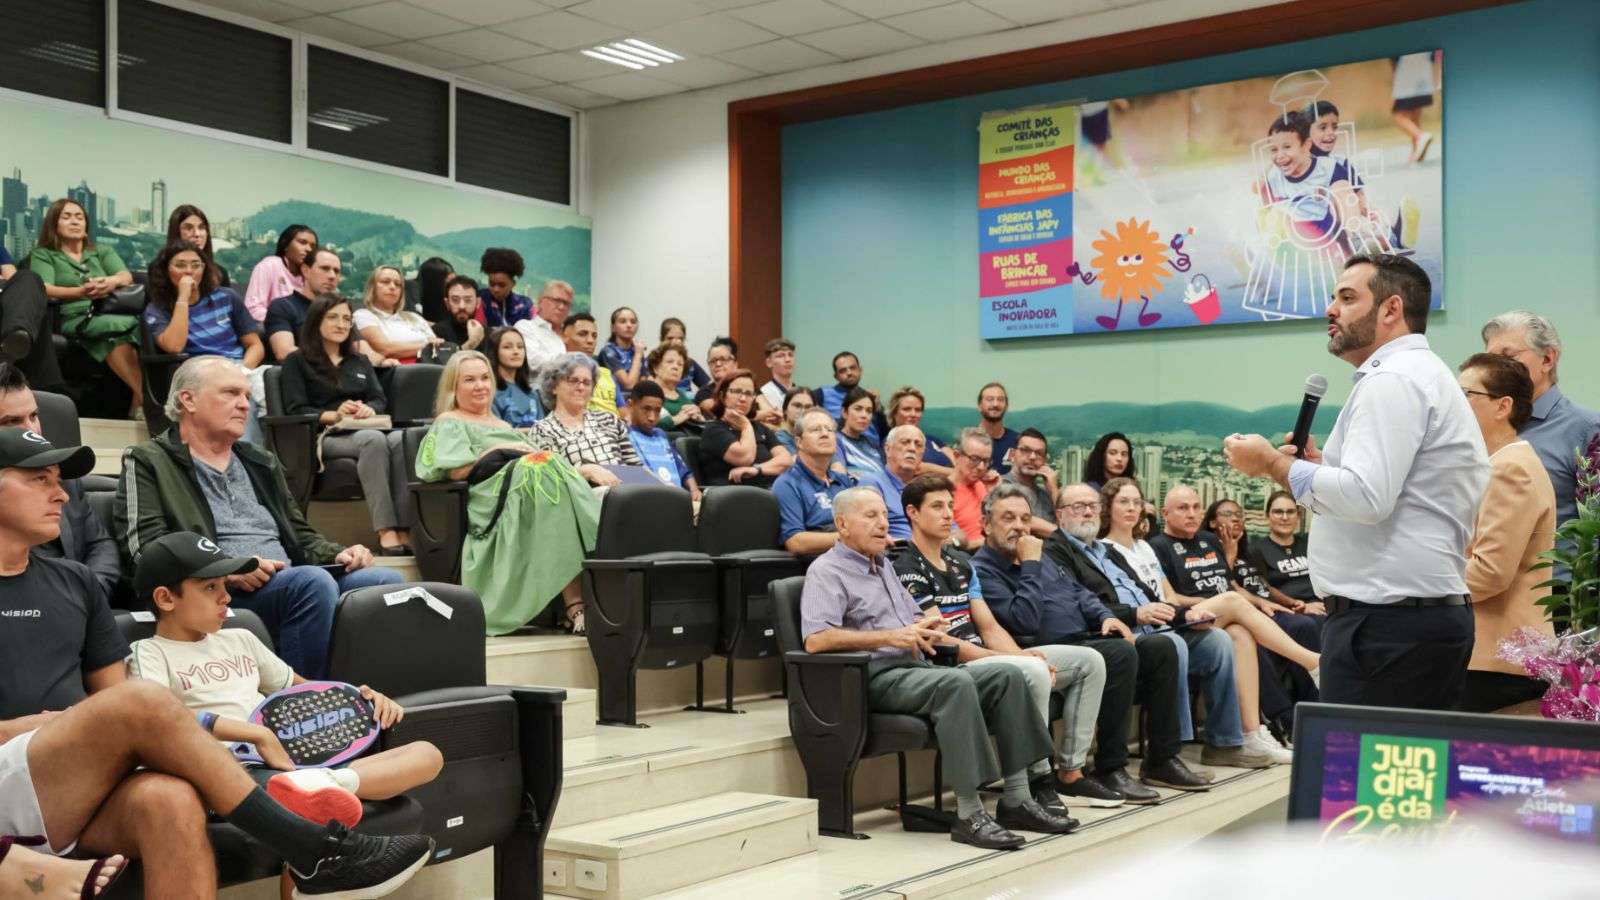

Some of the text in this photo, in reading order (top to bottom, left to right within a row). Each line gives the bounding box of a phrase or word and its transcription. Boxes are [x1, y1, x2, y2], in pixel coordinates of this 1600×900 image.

[997, 116, 1054, 133] COMITÊ DAS
[1013, 126, 1061, 141] CRIANÇAS
[998, 161, 1051, 178] MUNDO DAS
[1014, 171, 1057, 185] CRIANÇAS
[997, 208, 1053, 224] FÁBRICA DAS
[988, 219, 1061, 236] INFÂNCIAS JAPY
[992, 252, 1038, 269] RUAS DE
[1001, 263, 1049, 280] BRINCAR
[991, 298, 1028, 311] ESCOLA
[998, 308, 1057, 321] INOVADORA
[1377, 795, 1433, 820] é da
[1523, 799, 1576, 816] Atleta
